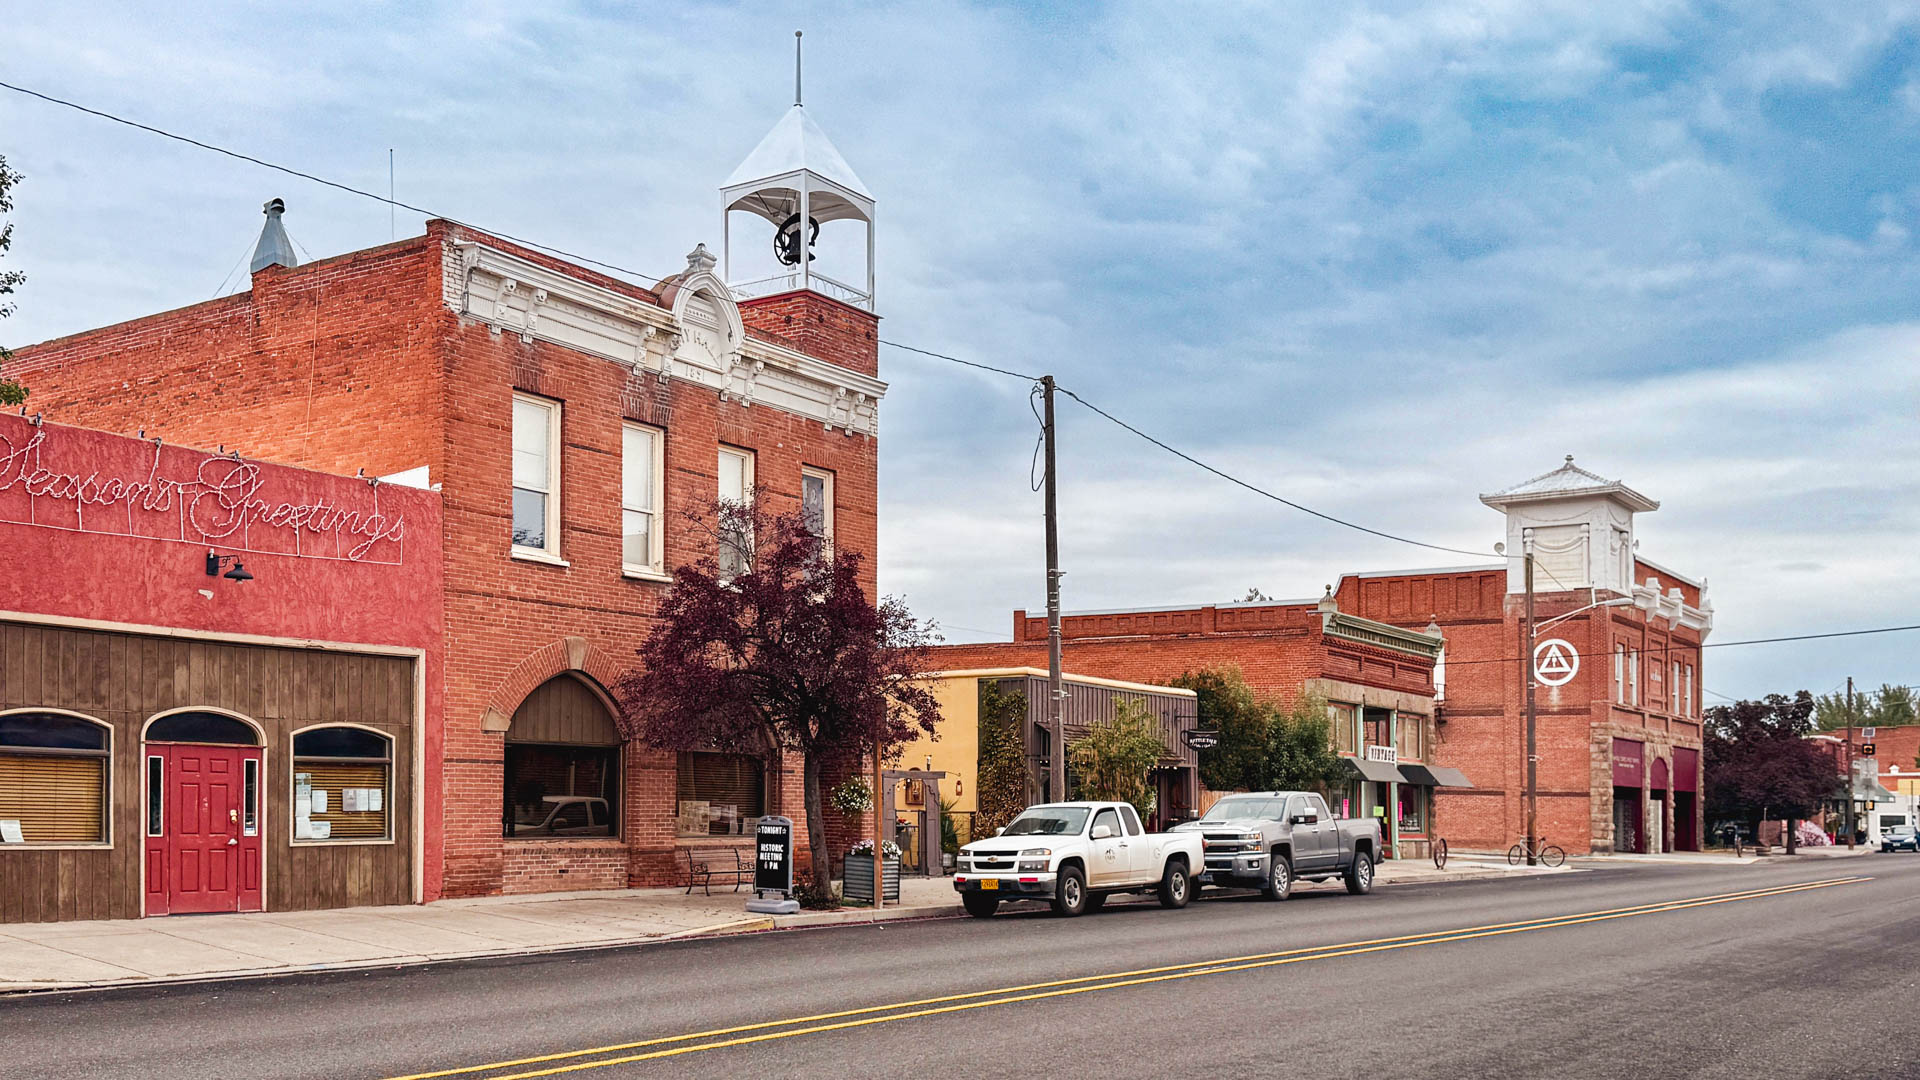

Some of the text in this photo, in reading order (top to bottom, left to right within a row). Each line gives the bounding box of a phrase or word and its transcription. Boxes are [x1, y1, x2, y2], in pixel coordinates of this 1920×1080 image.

[190, 454, 403, 561] Greetings
[1371, 748, 1395, 761] VINTAGE
[761, 826, 782, 834] TONIGHT
[760, 843, 784, 852] HISTORIC
[760, 852, 783, 861] MEETING
[769, 861, 778, 870] PM
